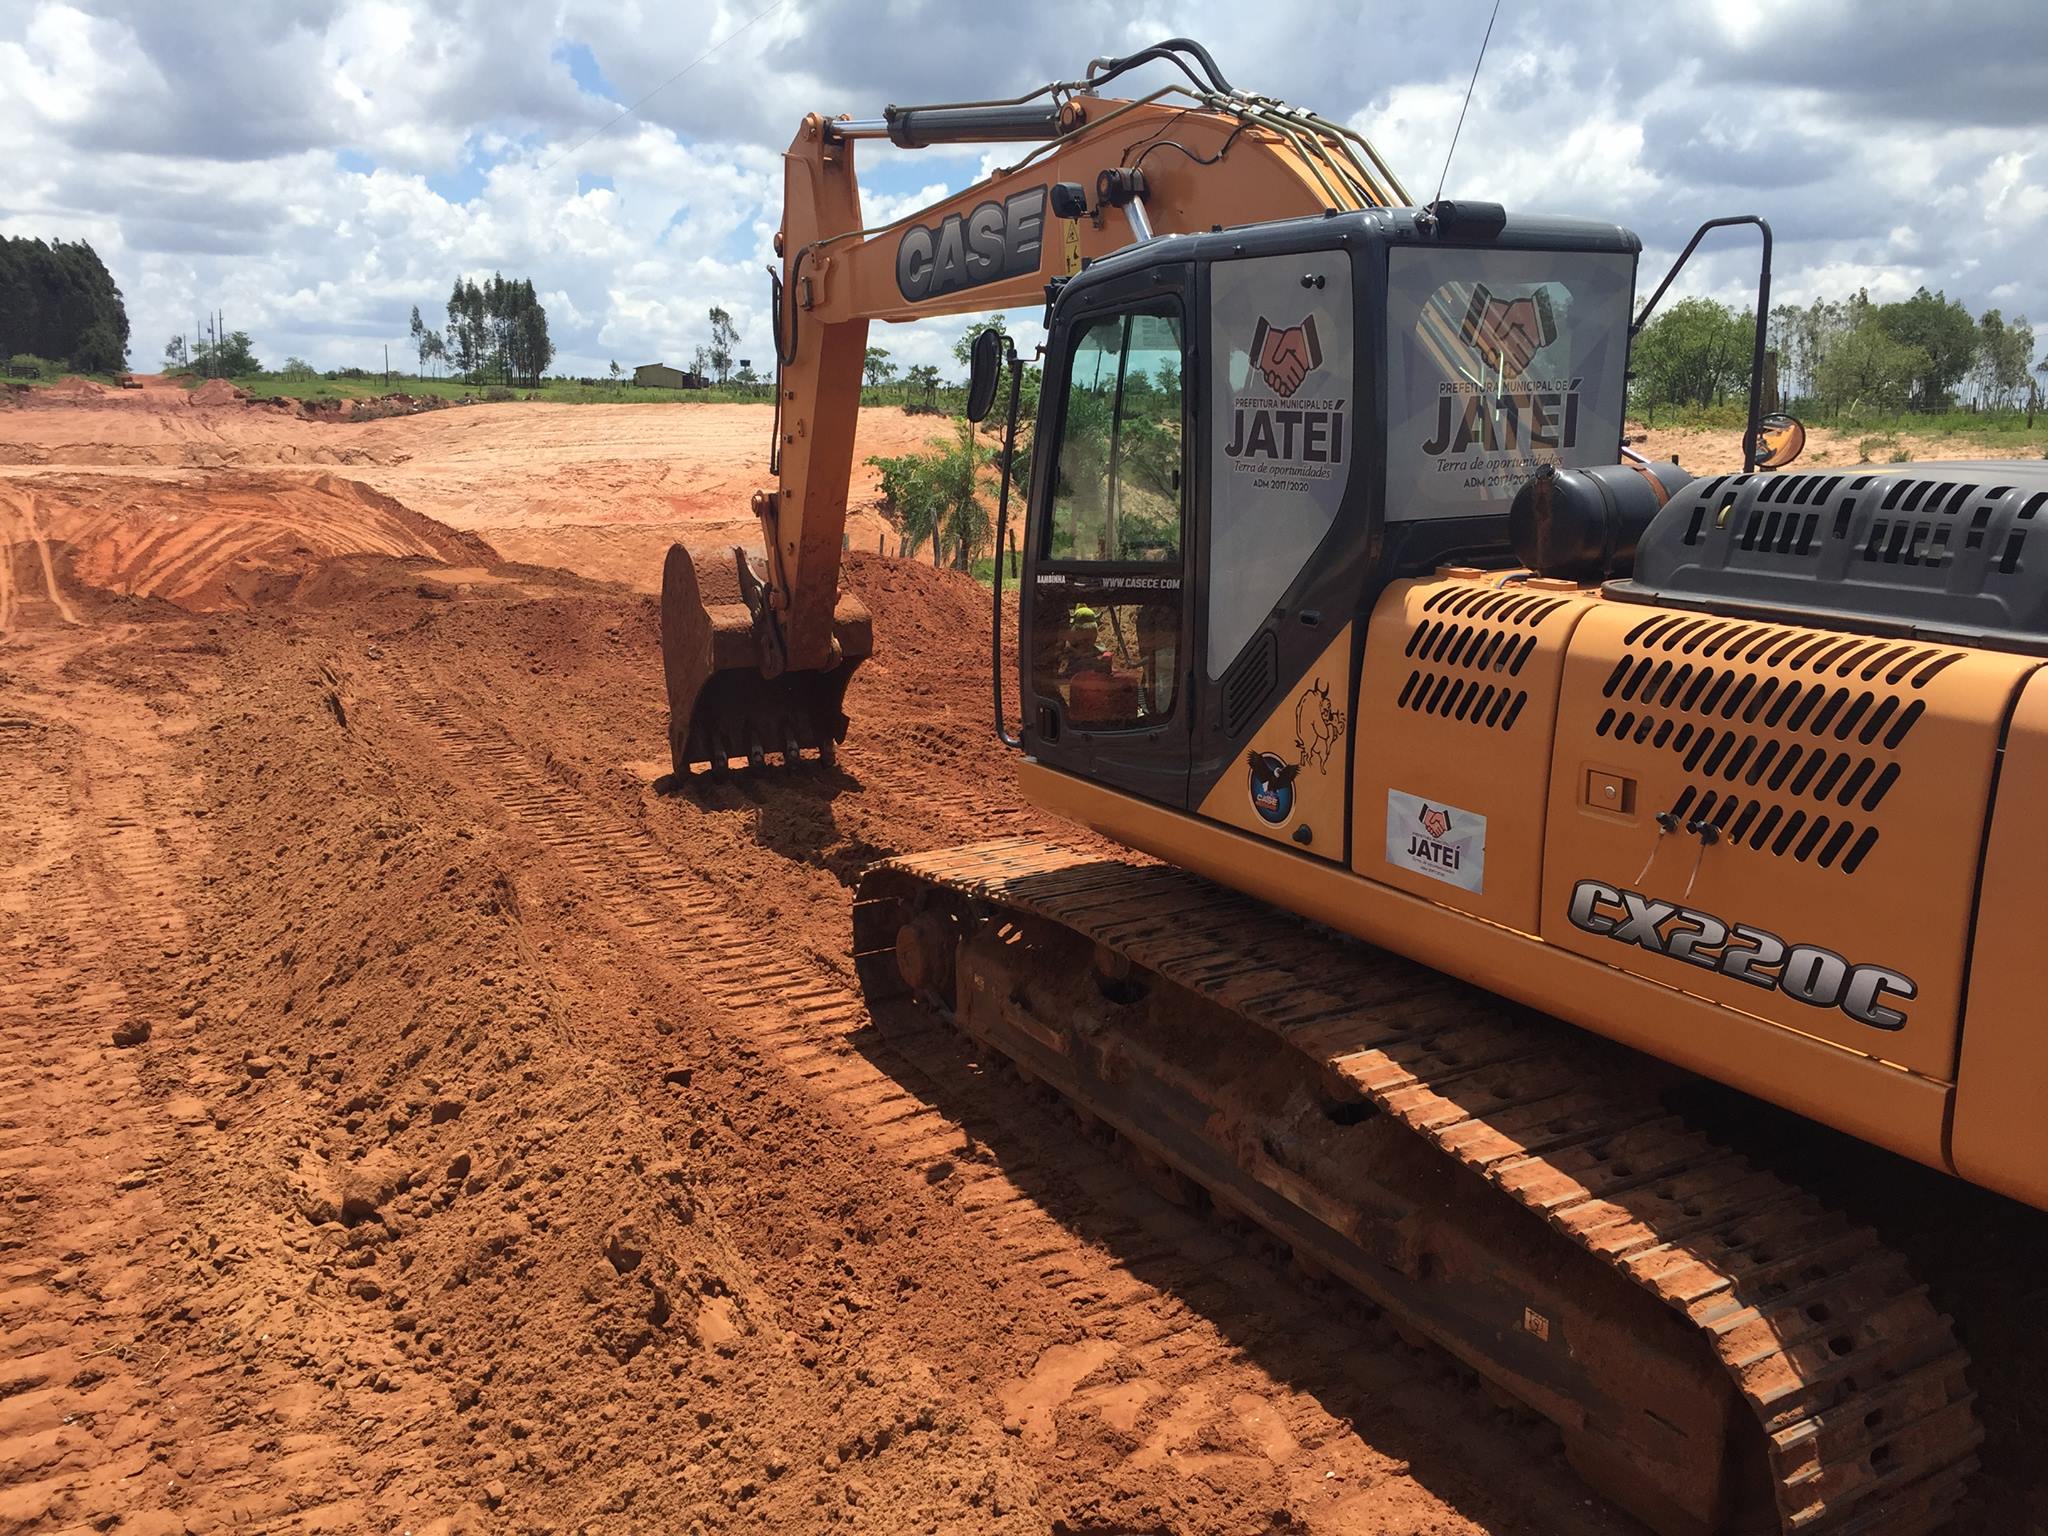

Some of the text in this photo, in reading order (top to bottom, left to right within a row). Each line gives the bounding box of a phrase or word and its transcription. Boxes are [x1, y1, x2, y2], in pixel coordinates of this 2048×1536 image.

[896, 184, 1047, 303] CASE
[1440, 379, 1568, 394] PREFEITURA MUNICIPAL DE
[1235, 398, 1333, 410] PREFEITURA MUNICIPAL DE
[1422, 378, 1584, 456] JATEÍ
[1224, 399, 1345, 464] JATEÍ
[1234, 460, 1331, 479] Terra de oportunidades
[1437, 454, 1564, 473] Terra de oportunidades
[1253, 479, 1309, 492] ADM 2017/2020
[1463, 477, 1485, 489] ADM
[1407, 835, 1461, 870] JATEÍ
[1566, 878, 1919, 1033] CX220C
